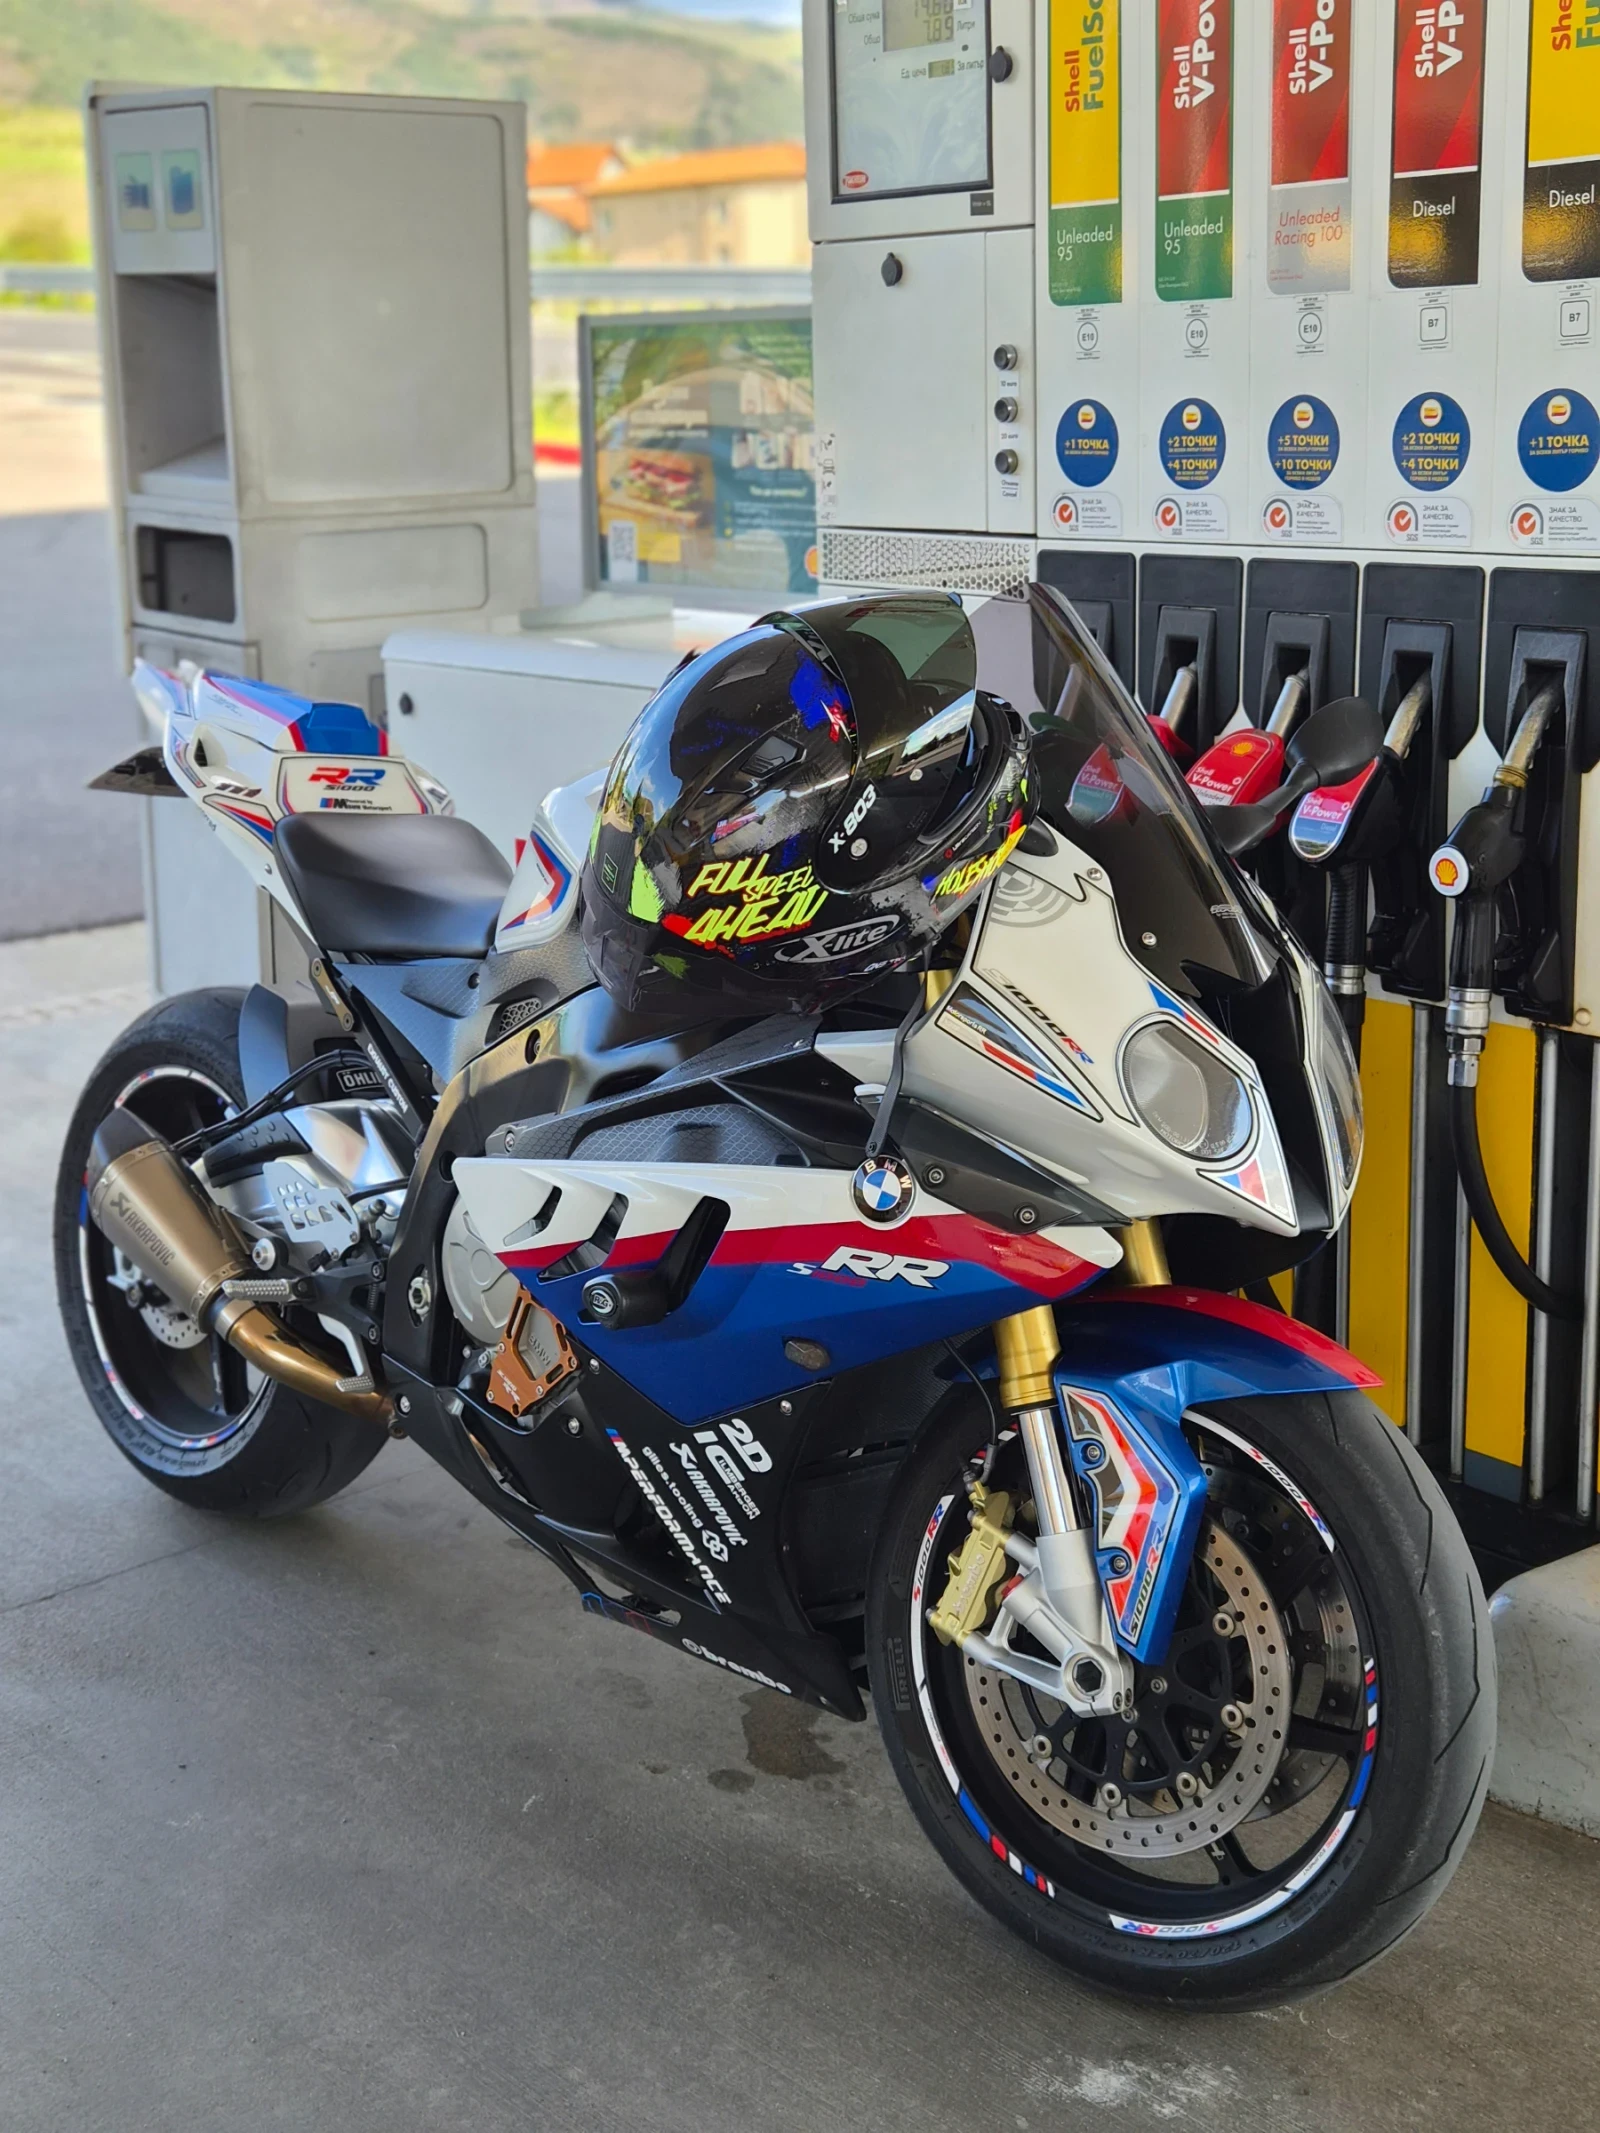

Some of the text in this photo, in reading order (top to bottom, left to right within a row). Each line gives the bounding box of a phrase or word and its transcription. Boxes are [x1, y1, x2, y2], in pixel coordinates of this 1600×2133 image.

[1414, 8, 1436, 78] Shell
[1436, 0, 1464, 76] V-P
[1288, 28, 1307, 95] Shell
[1064, 50, 1080, 113] Shell
[1173, 45, 1190, 109] Shell
[1549, 185, 1595, 208] Diesel
[1279, 206, 1340, 228] Unleaded
[1413, 197, 1455, 218] Diesel
[1057, 225, 1113, 246] Unleaded
[1164, 217, 1223, 239] Unleaded
[1274, 225, 1344, 247] Racing 100
[1057, 246, 1073, 261] 95
[1164, 239, 1181, 255] 95
[1428, 319, 1439, 328] B7
[1568, 313, 1581, 322] B7
[1082, 333, 1095, 342] E10
[1190, 330, 1203, 339] E10
[1303, 324, 1318, 333] E10
[1064, 439, 1110, 450] +1 ТОЧКА
[1167, 435, 1217, 447] +2 ТОЧКИ
[1278, 435, 1329, 446] +5 ТОЧКИ
[1401, 432, 1460, 445] +2 ТОЧКИ
[1529, 435, 1590, 448] +1 ТОЧКА
[1167, 458, 1217, 470] +4 ТОЧКИ
[1274, 459, 1332, 470] +10 ТОЧКИ
[1401, 458, 1459, 470] +4 ТОЧКИ
[310, 766, 386, 785] RR
[1195, 766, 1215, 776] Shell
[1080, 772, 1119, 790] V-Power
[1192, 773, 1235, 792] V-Power
[827, 784, 877, 855] X-803
[1302, 804, 1344, 820] V-Power
[788, 924, 889, 962] X-lite
[863, 1158, 913, 1189] BMW
[820, 1245, 951, 1289] RR
[641, 1446, 704, 1529] gilles.tooling
[912, 1503, 945, 1603] S1000RR
[1130, 1526, 1165, 1638] S1000RR
[699, 1645, 792, 1694] brembo
